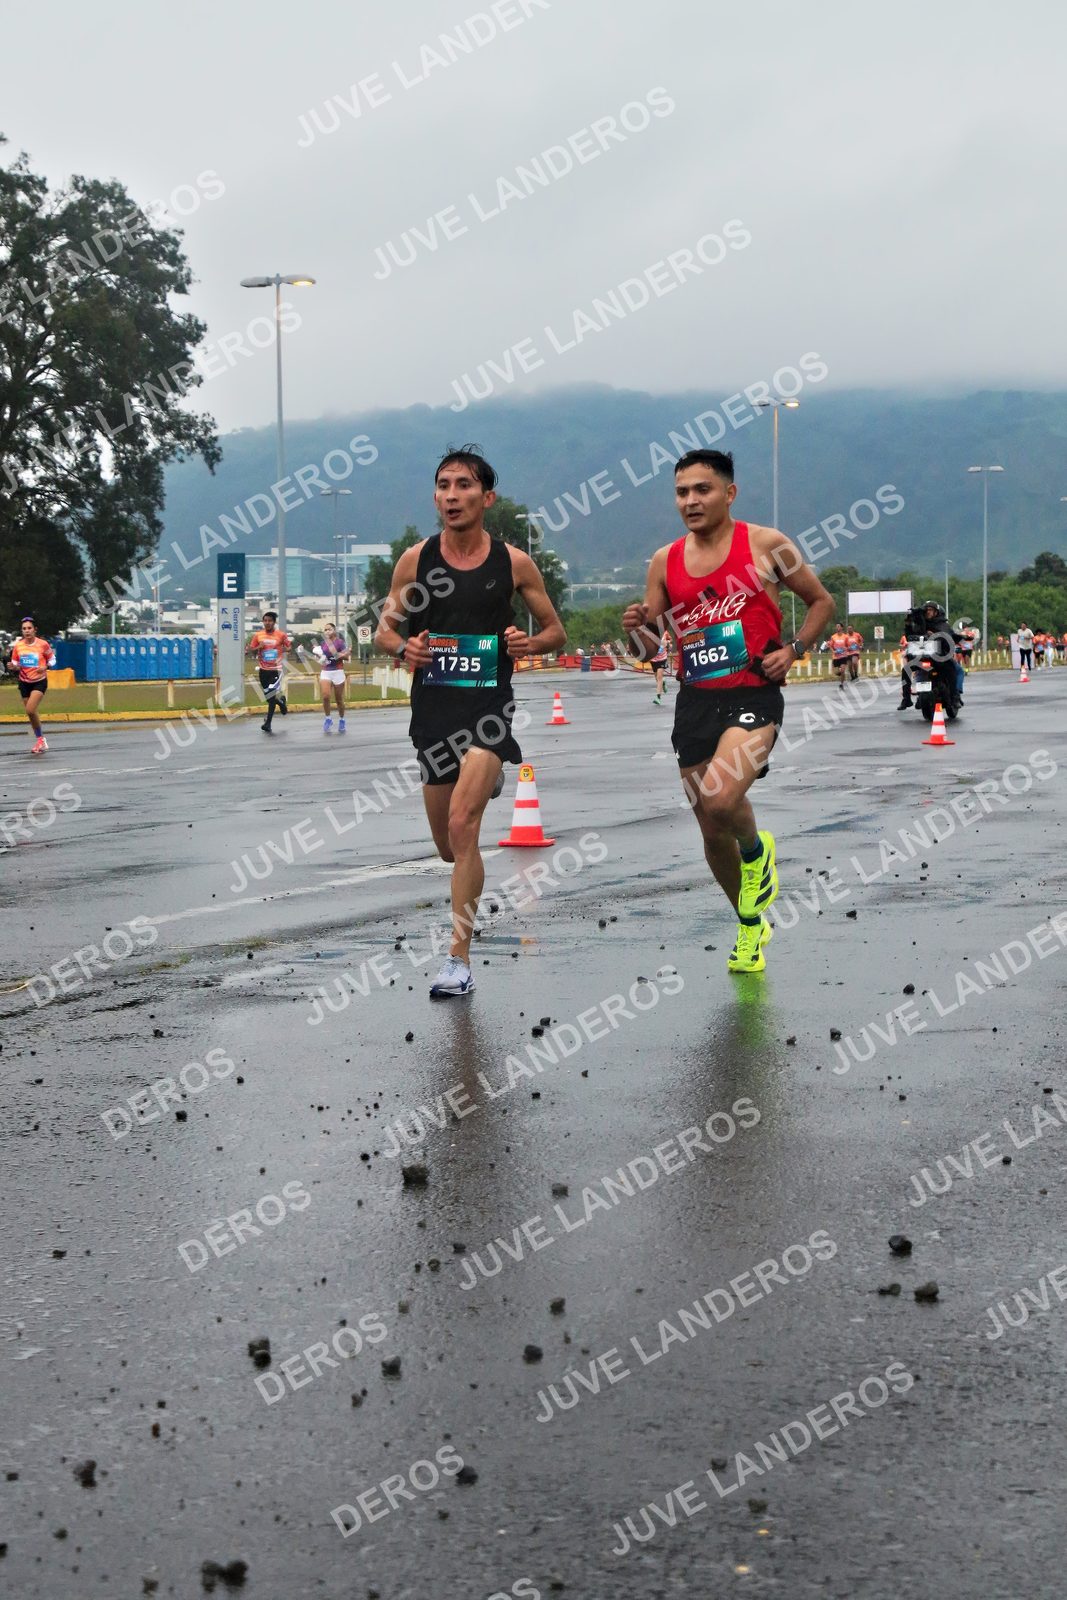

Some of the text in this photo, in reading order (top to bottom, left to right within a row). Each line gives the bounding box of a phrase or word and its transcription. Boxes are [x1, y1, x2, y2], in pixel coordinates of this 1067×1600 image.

[223, 572, 238, 592] E
[722, 624, 736, 637] 10K
[478, 639, 493, 650] 10K
[437, 656, 481, 672] 1735
[690, 645, 729, 667] 1662
